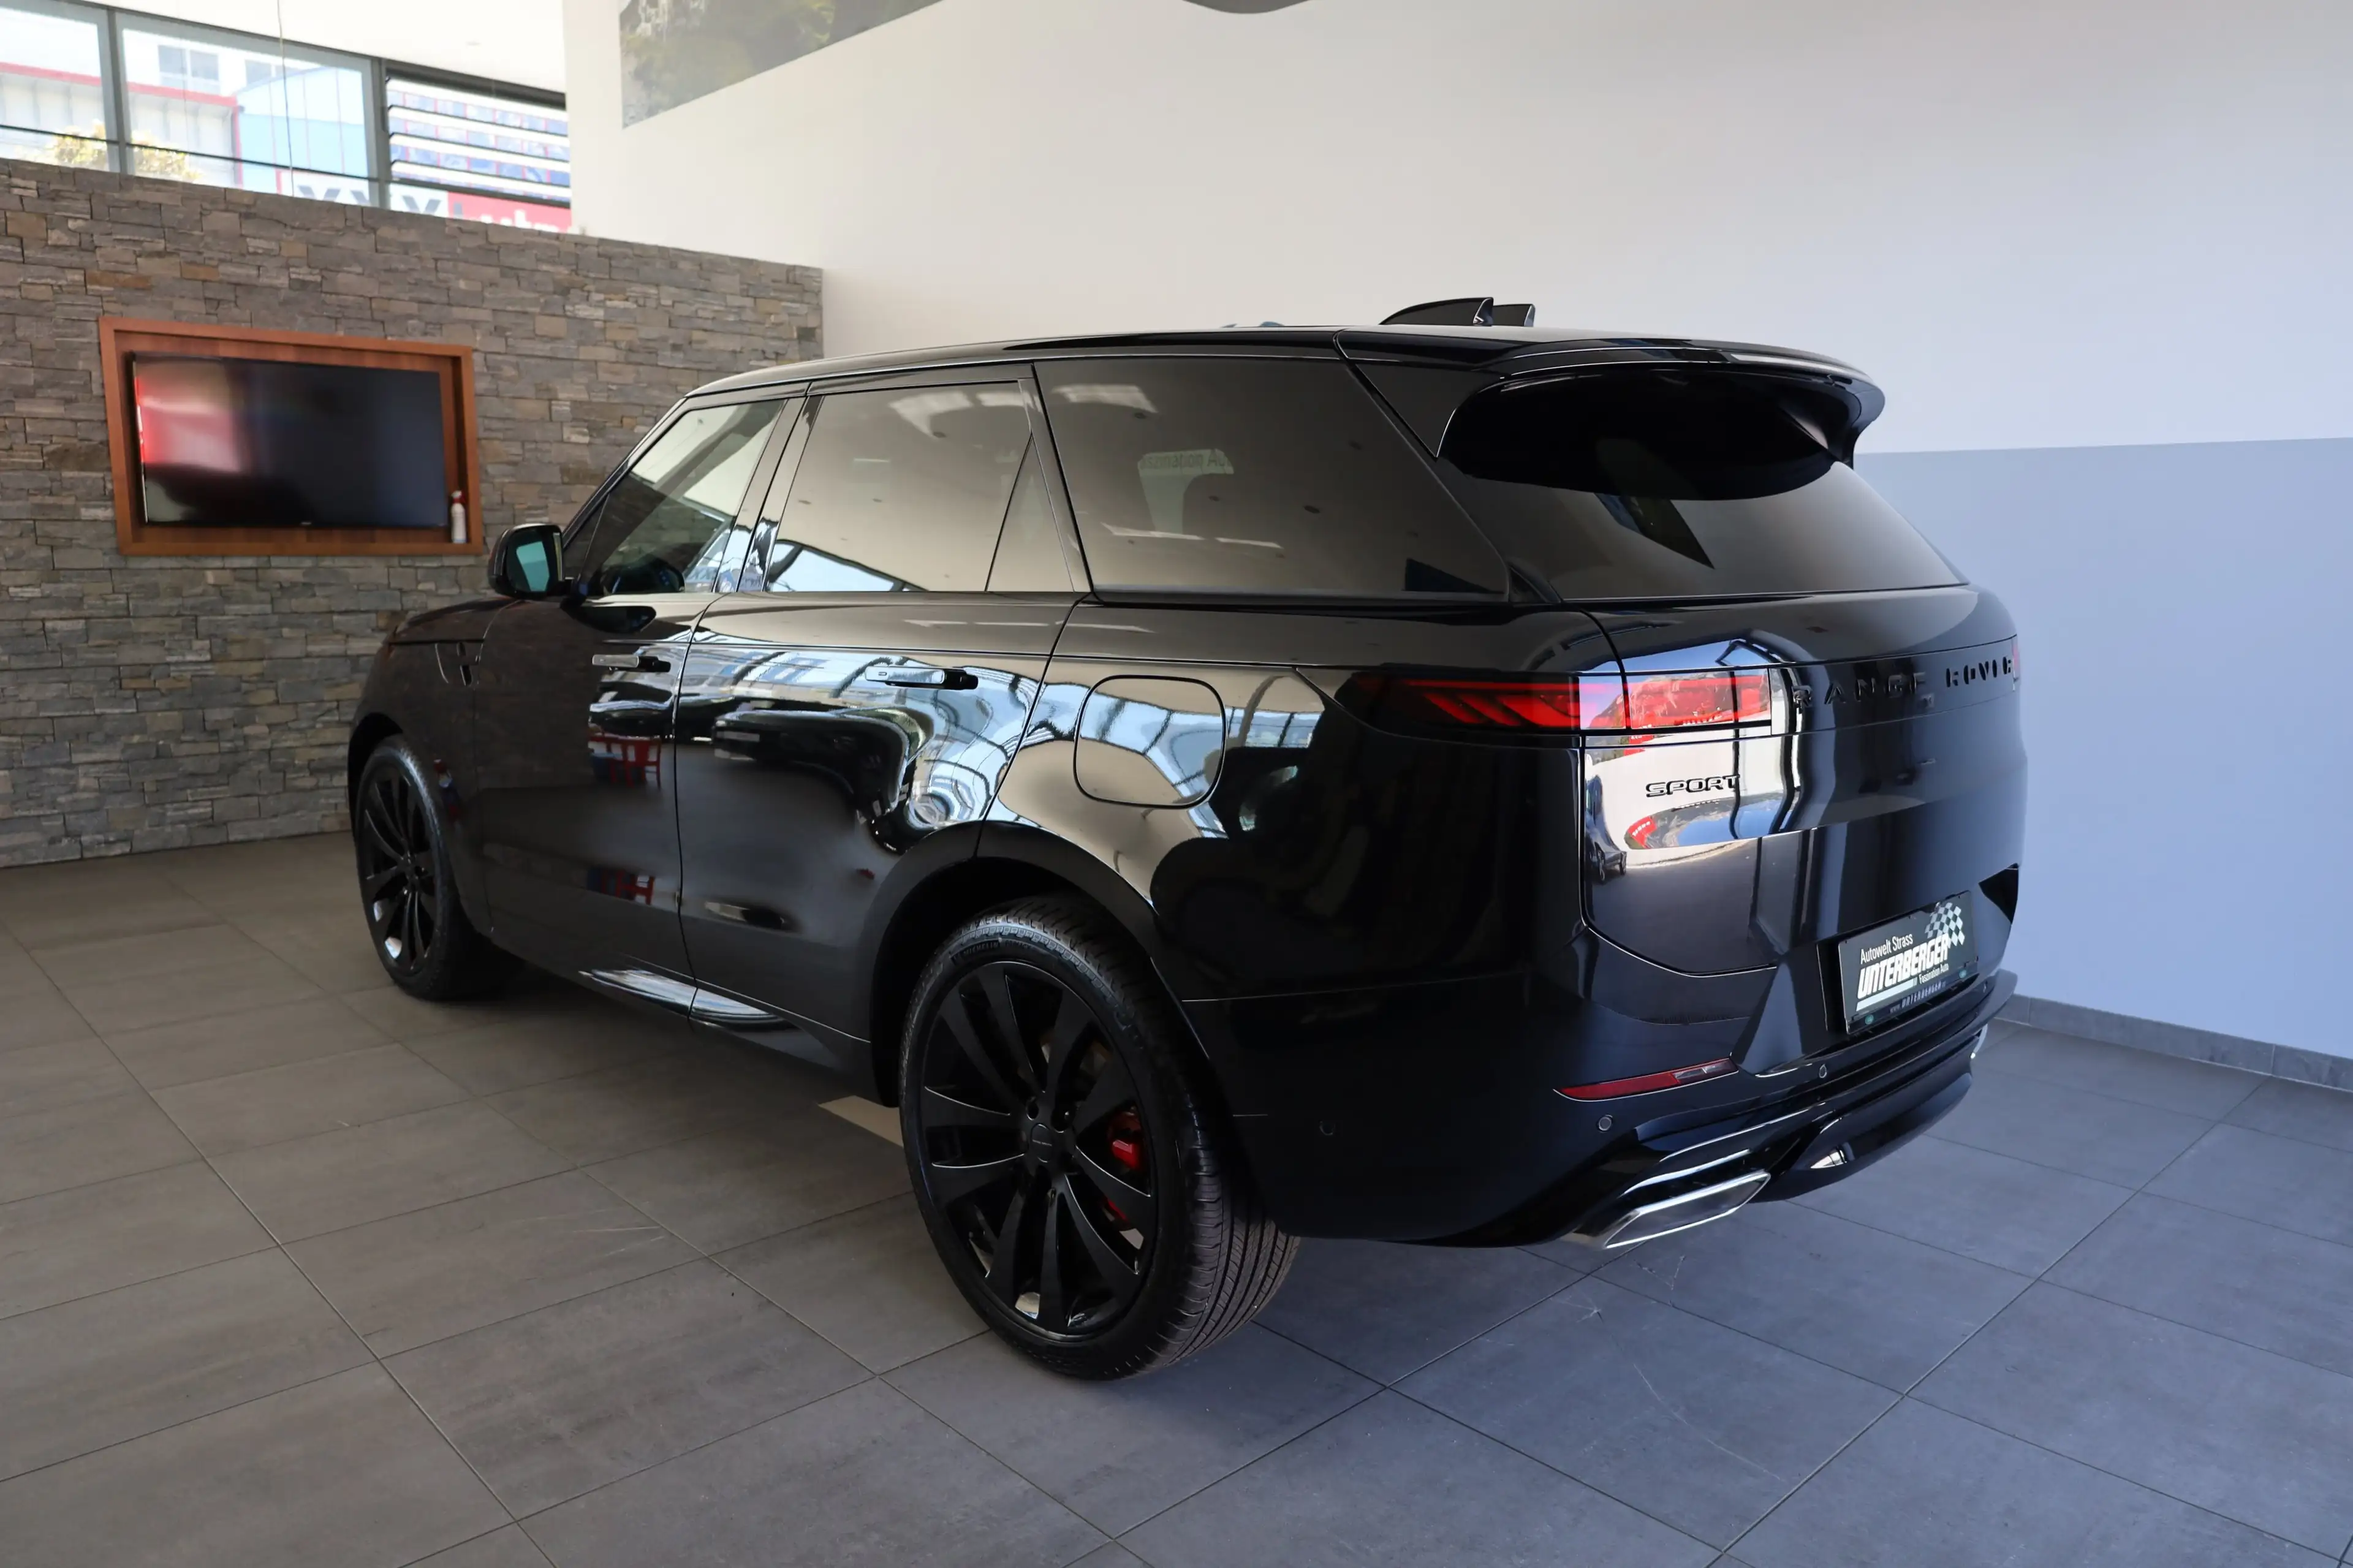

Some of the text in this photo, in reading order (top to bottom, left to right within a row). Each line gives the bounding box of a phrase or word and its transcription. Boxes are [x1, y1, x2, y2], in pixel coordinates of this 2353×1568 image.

[1645, 774, 1740, 798] SPORT
[1860, 934, 1914, 964] Autowelt Strass
[1857, 933, 1950, 999] UNTERBERGER
